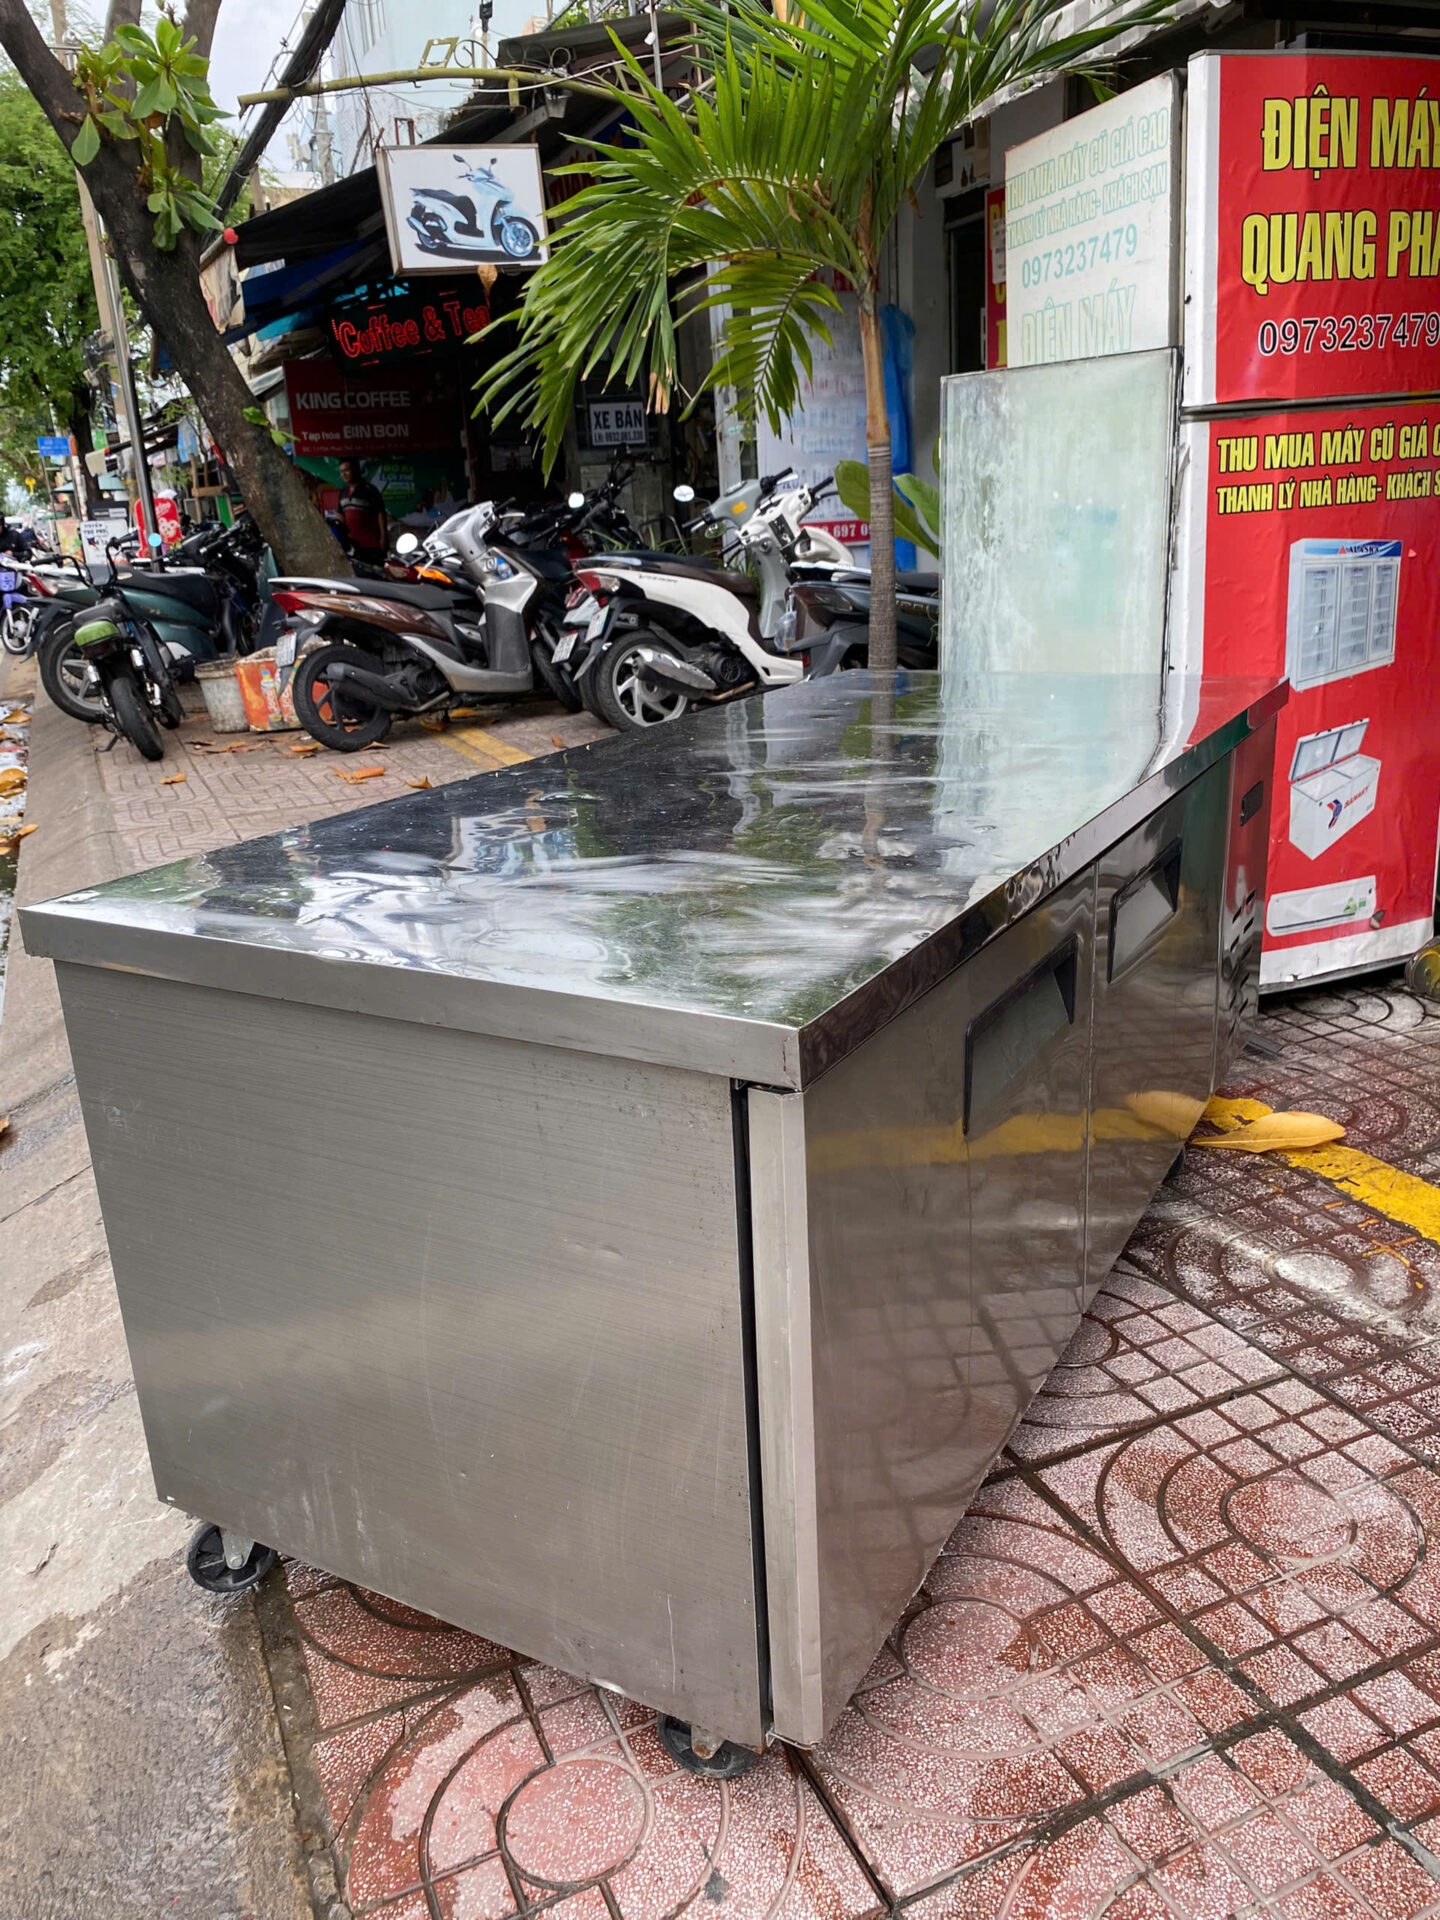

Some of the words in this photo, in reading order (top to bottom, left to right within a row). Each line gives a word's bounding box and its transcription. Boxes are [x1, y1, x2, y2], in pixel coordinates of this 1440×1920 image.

[1028, 159, 1056, 203] MUA
[1058, 141, 1087, 190] MÁY
[1089, 129, 1109, 176] CŨ
[1110, 116, 1135, 168] GIÁ
[1137, 107, 1169, 158] CAO
[1261, 82, 1359, 180] ĐIỆN
[1102, 172, 1140, 215] KHÁCH
[1141, 162, 1168, 203] SẠN
[1022, 223, 1137, 288] 0973237479
[1241, 209, 1377, 296] QUANG
[338, 314, 420, 358] Coffee
[422, 305, 446, 341] &
[443, 301, 491, 336] Tea
[1078, 277, 1136, 357] MÁY
[1258, 311, 1440, 356] 0973237479
[296, 392, 341, 410] KING
[344, 391, 411, 409] COFFEE
[594, 410, 610, 430] XE
[615, 405, 642, 429] BÁN
[343, 425, 371, 439] BIN
[374, 424, 409, 438] BON
[1217, 436, 1258, 474] THU
[1263, 432, 1315, 470] MUA
[1320, 423, 1366, 466] MÁY
[1370, 420, 1394, 462] CŨ
[1398, 418, 1428, 459] GIÁ
[1216, 482, 1273, 514] THANH
[1277, 476, 1296, 511] LÝ
[1299, 474, 1332, 508] NHÀ
[1386, 467, 1431, 501] KHÁCH
[833, 524, 856, 537] 697
